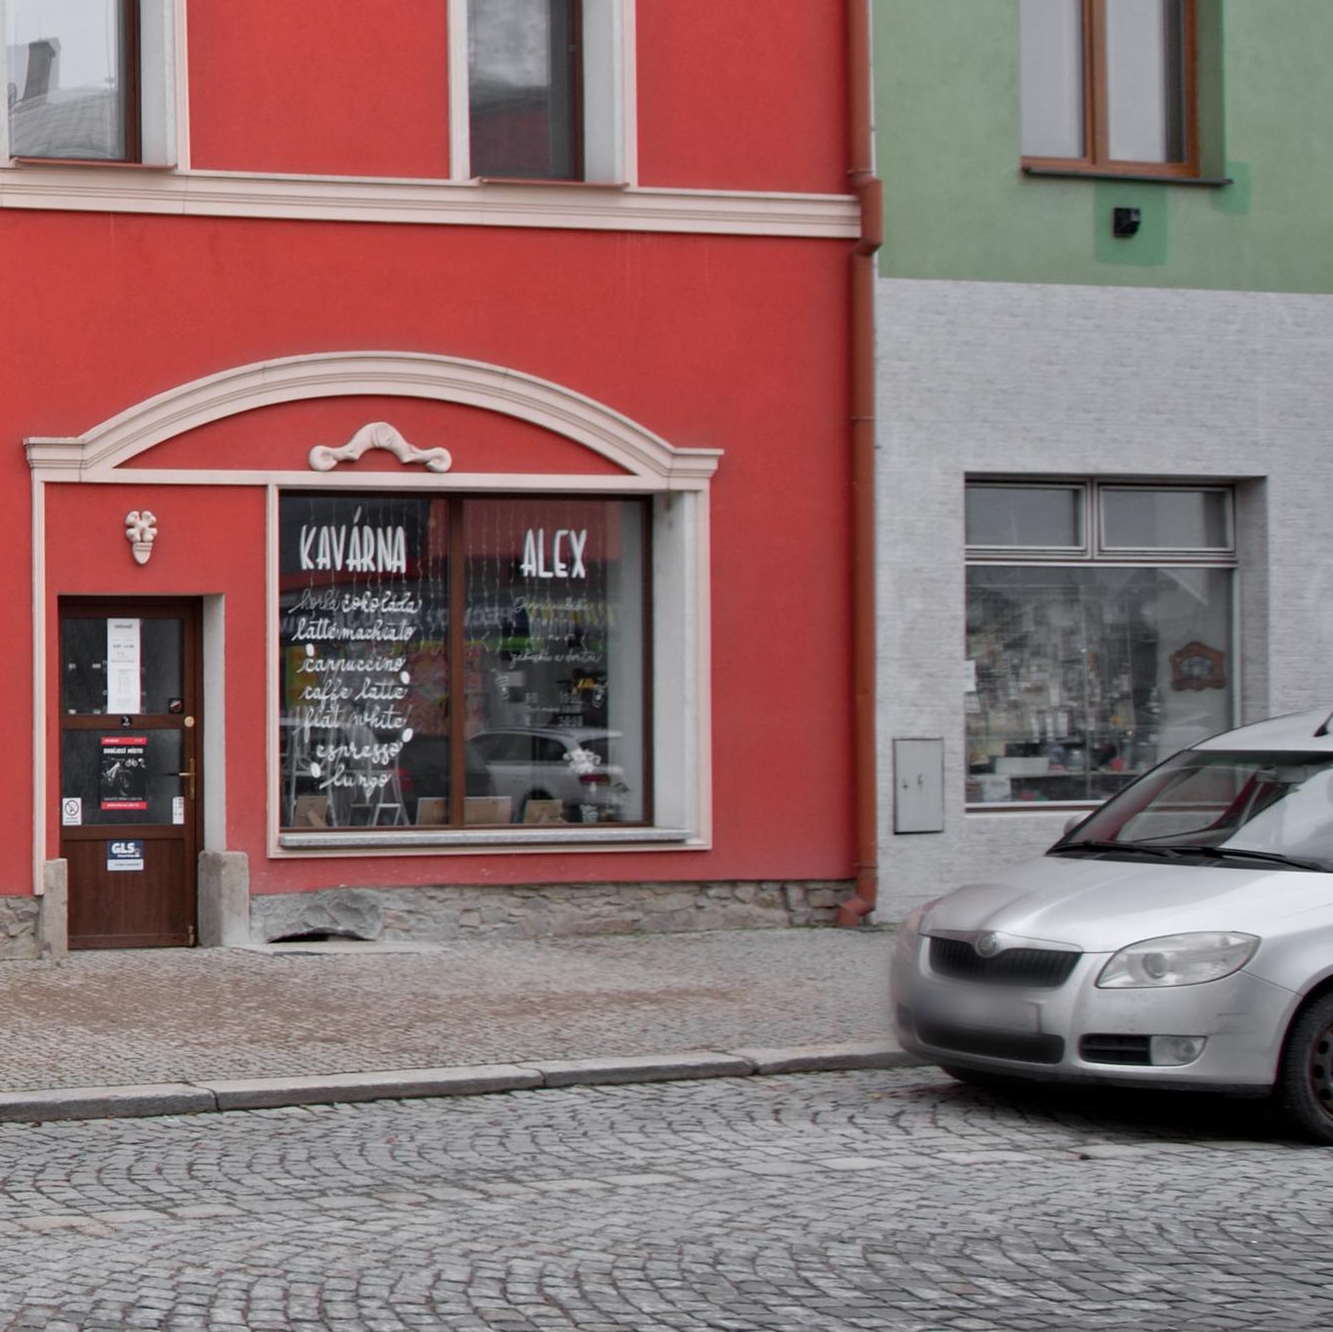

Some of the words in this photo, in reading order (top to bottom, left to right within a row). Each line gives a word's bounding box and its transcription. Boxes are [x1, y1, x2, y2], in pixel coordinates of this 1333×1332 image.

[299, 505, 407, 574] KAVÁRNA
[520, 527, 588, 579] ALEX
[341, 590, 423, 614] čokoláda
[296, 654, 407, 681] cappuccino
[354, 677, 409, 701] latte
[293, 705, 342, 744] flat
[316, 740, 404, 766] espresso
[319, 762, 393, 798] lungo
[111, 842, 135, 855] GLS
